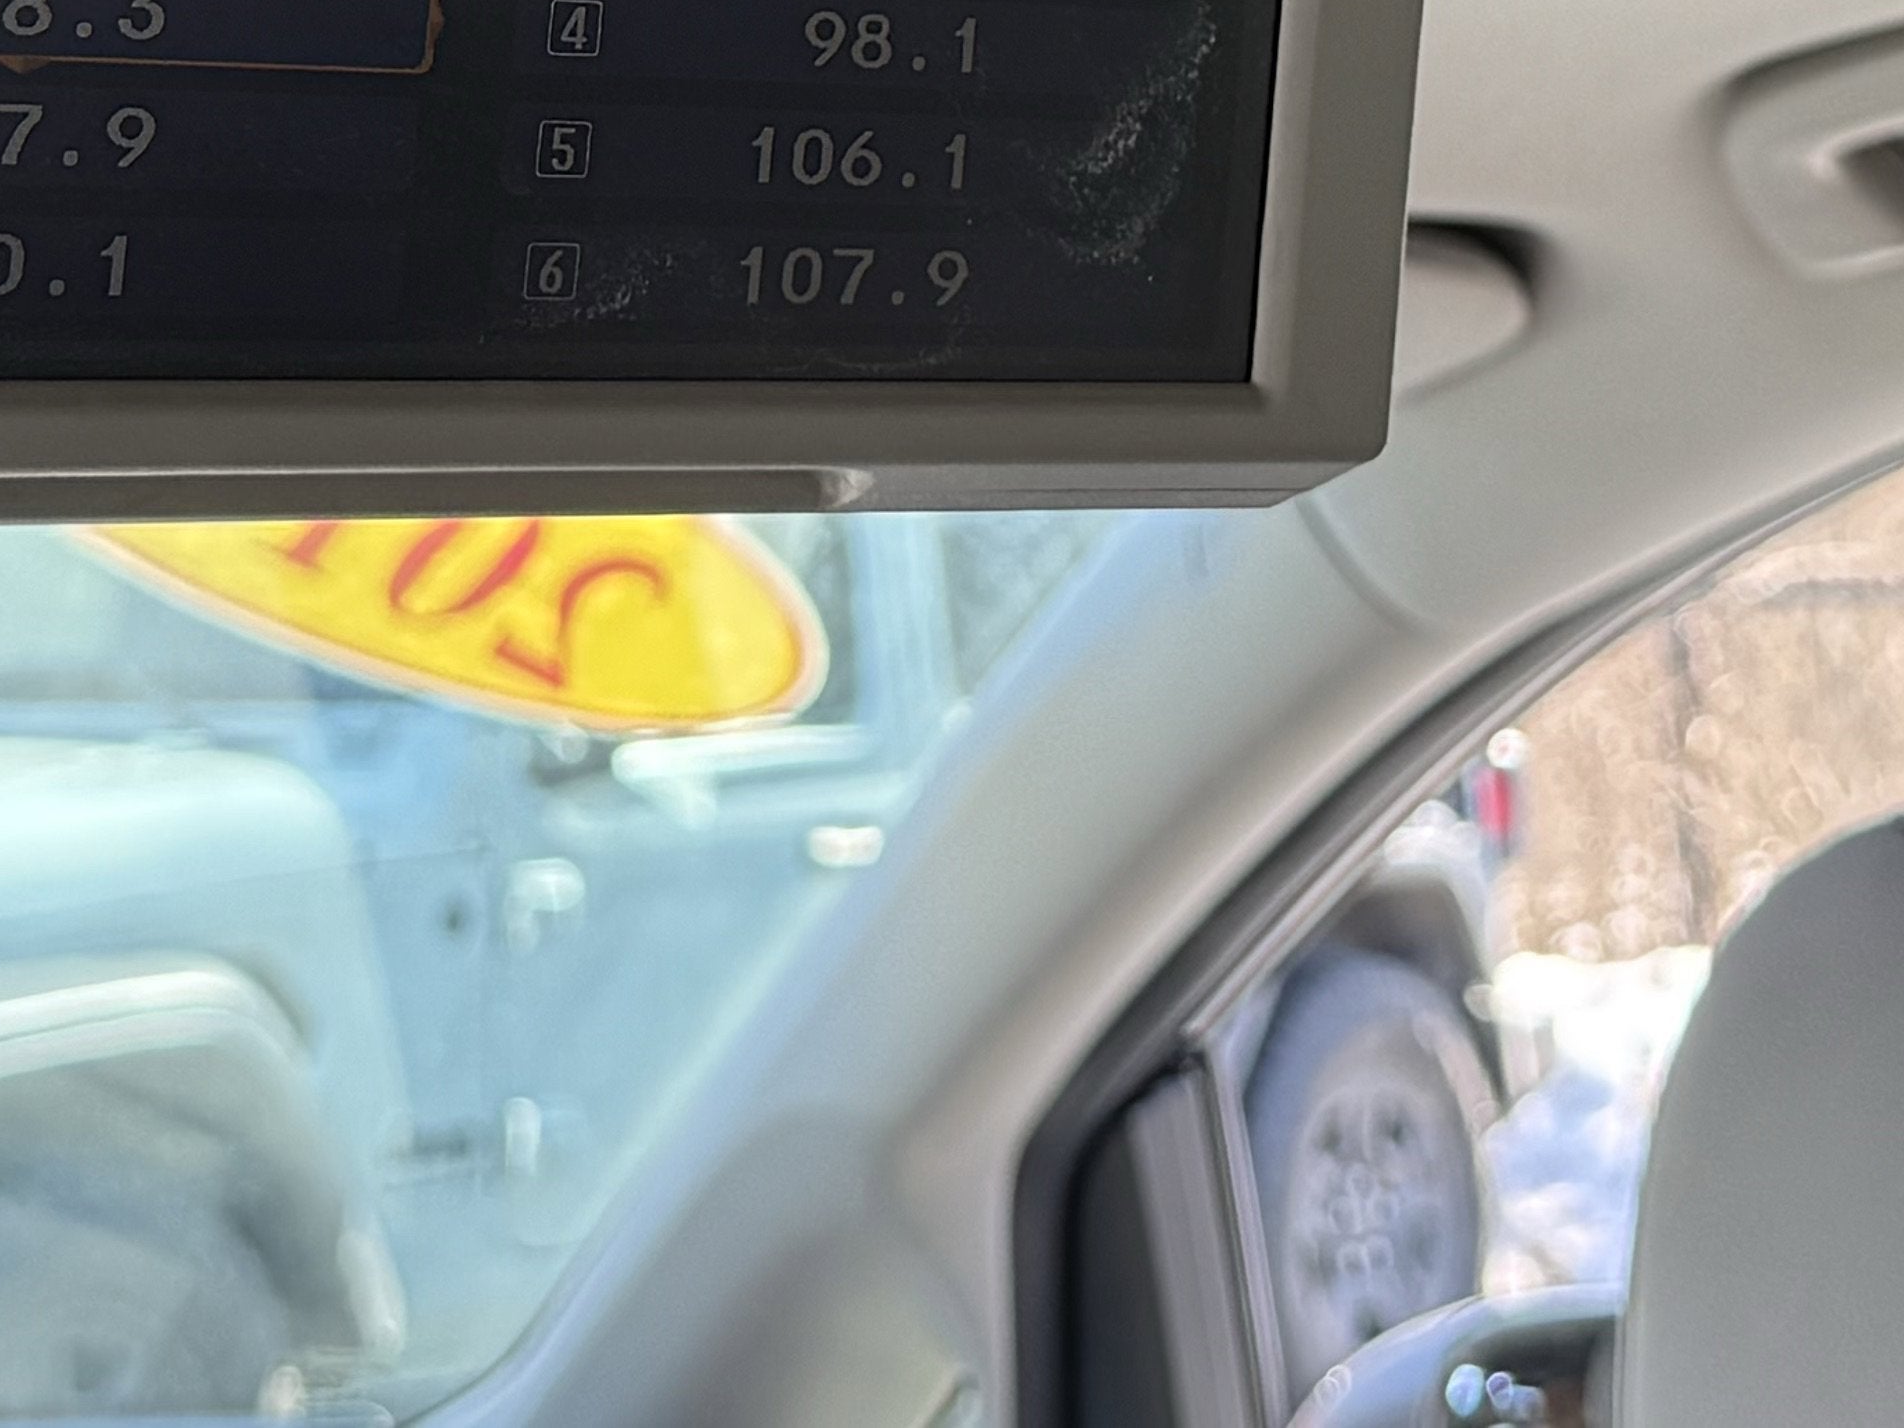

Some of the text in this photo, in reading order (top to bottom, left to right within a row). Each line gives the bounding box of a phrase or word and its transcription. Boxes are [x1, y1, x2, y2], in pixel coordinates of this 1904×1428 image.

[558, 3, 980, 76] 4 98.1
[548, 123, 969, 191] 5 106.1
[536, 242, 971, 308] 6 107.9
